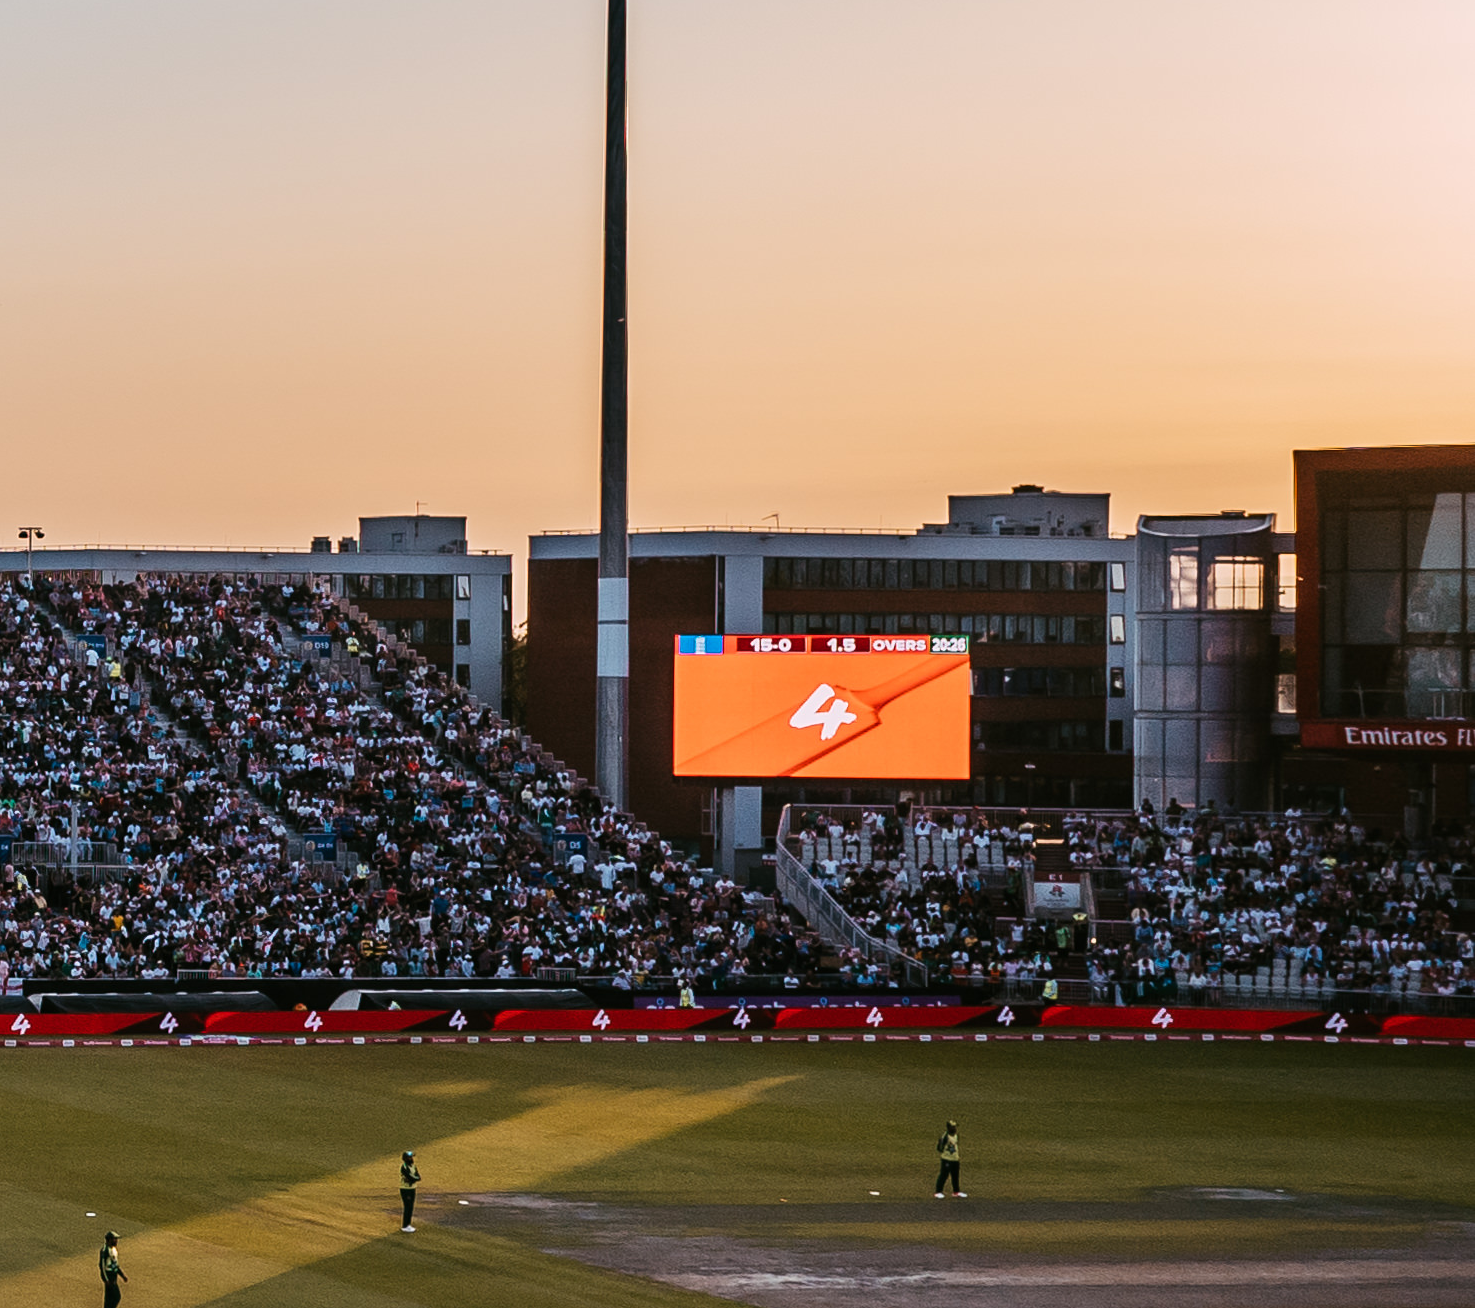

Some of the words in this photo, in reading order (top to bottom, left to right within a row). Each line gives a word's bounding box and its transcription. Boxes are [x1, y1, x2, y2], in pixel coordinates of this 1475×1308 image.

[749, 637, 792, 653] 15-0
[826, 637, 857, 653] 1.5
[872, 639, 927, 653] OVERS
[931, 637, 967, 653] 20:26
[789, 683, 858, 741] 4
[1344, 726, 1448, 746] Emirates
[1457, 728, 1475, 746] FL
[11, 1013, 31, 1035] 4
[159, 1012, 179, 1034] 4
[304, 1010, 323, 1032] 4
[449, 1009, 468, 1031] 4
[592, 1009, 611, 1031] 4
[733, 1006, 751, 1029] 4
[866, 1006, 884, 1028] 4
[997, 1005, 1015, 1026] 4
[1151, 1007, 1174, 1029] 4
[1325, 1012, 1348, 1033] 4
